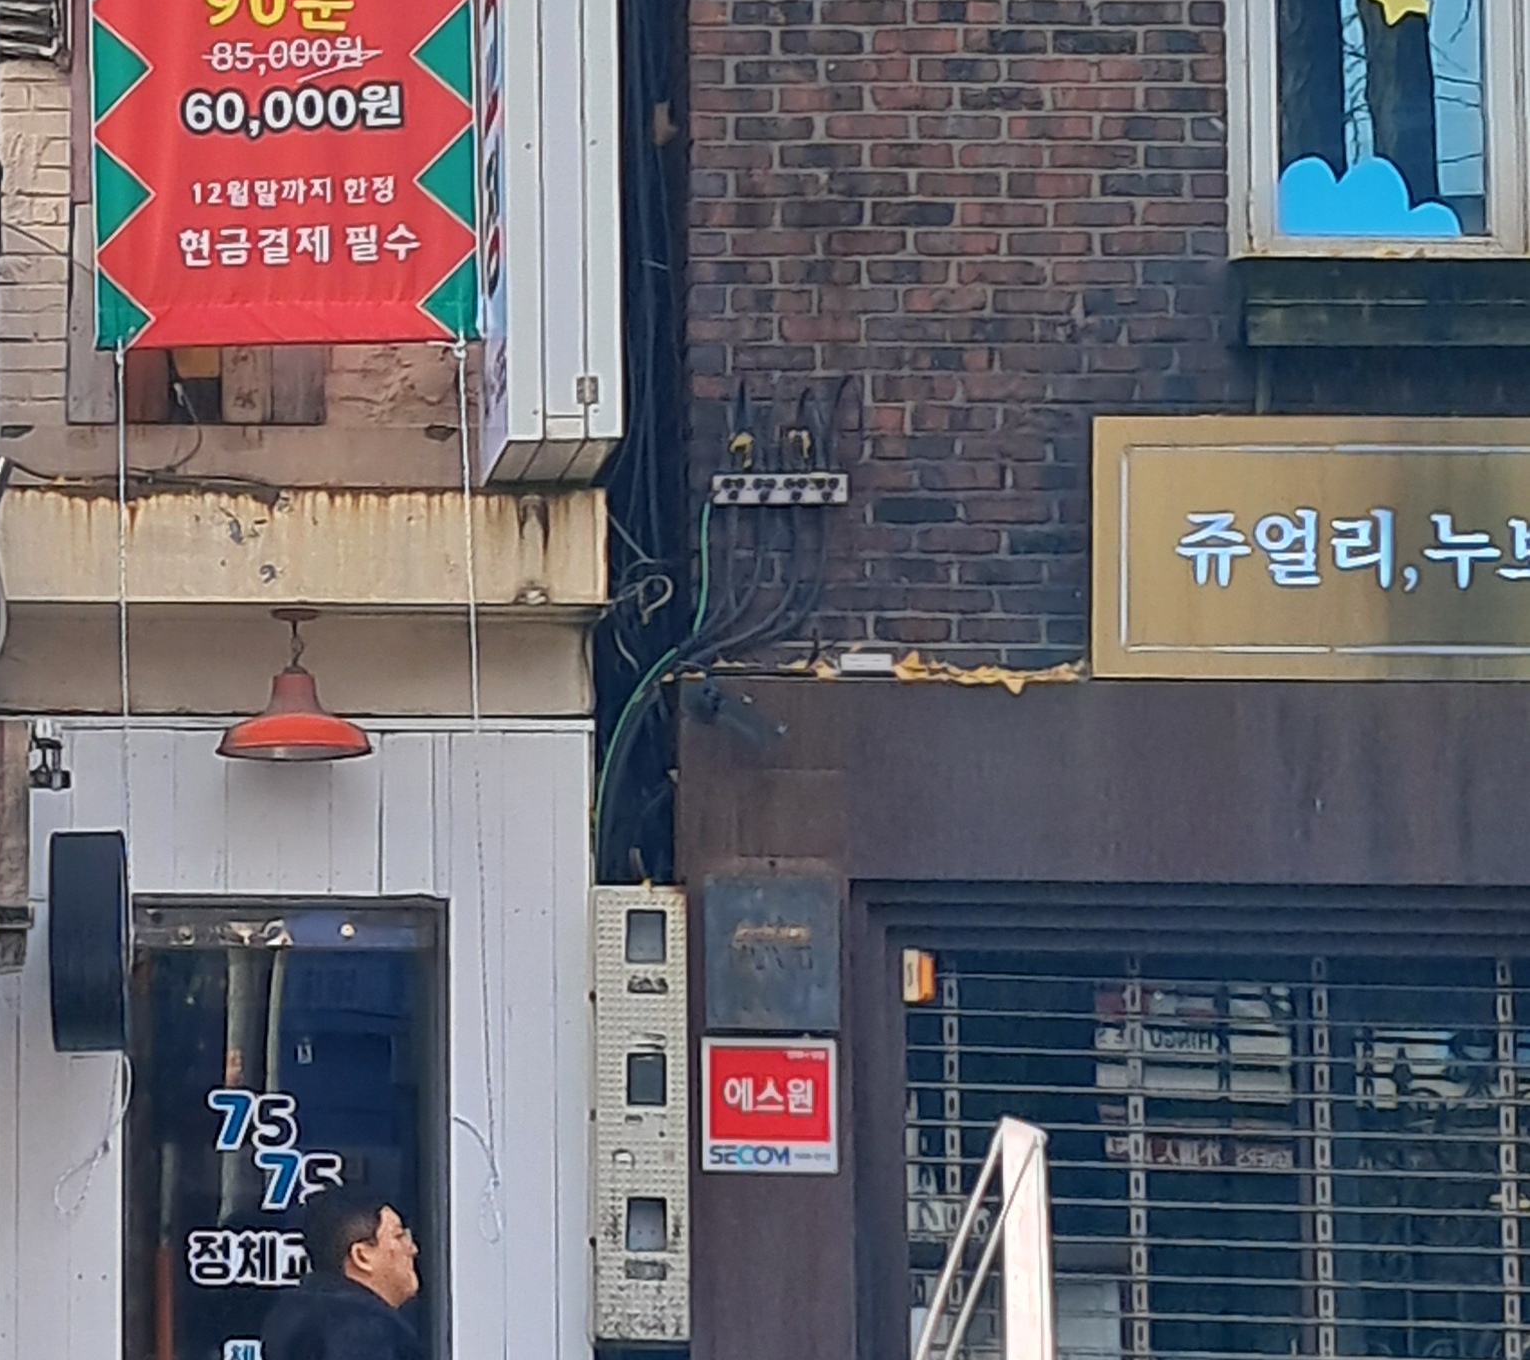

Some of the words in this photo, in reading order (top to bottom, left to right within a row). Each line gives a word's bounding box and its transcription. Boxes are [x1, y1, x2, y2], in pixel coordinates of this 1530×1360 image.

[210, 37, 365, 76] 85,000원
[183, 86, 403, 137] 60,000원
[191, 178, 332, 208] 12월말까지
[343, 176, 396, 205] 한정
[178, 225, 330, 267] 현금결제
[345, 223, 422, 263] 필수
[724, 1076, 813, 1114] 에스원
[208, 1089, 297, 1151] 75
[710, 1145, 791, 1165] SECOM
